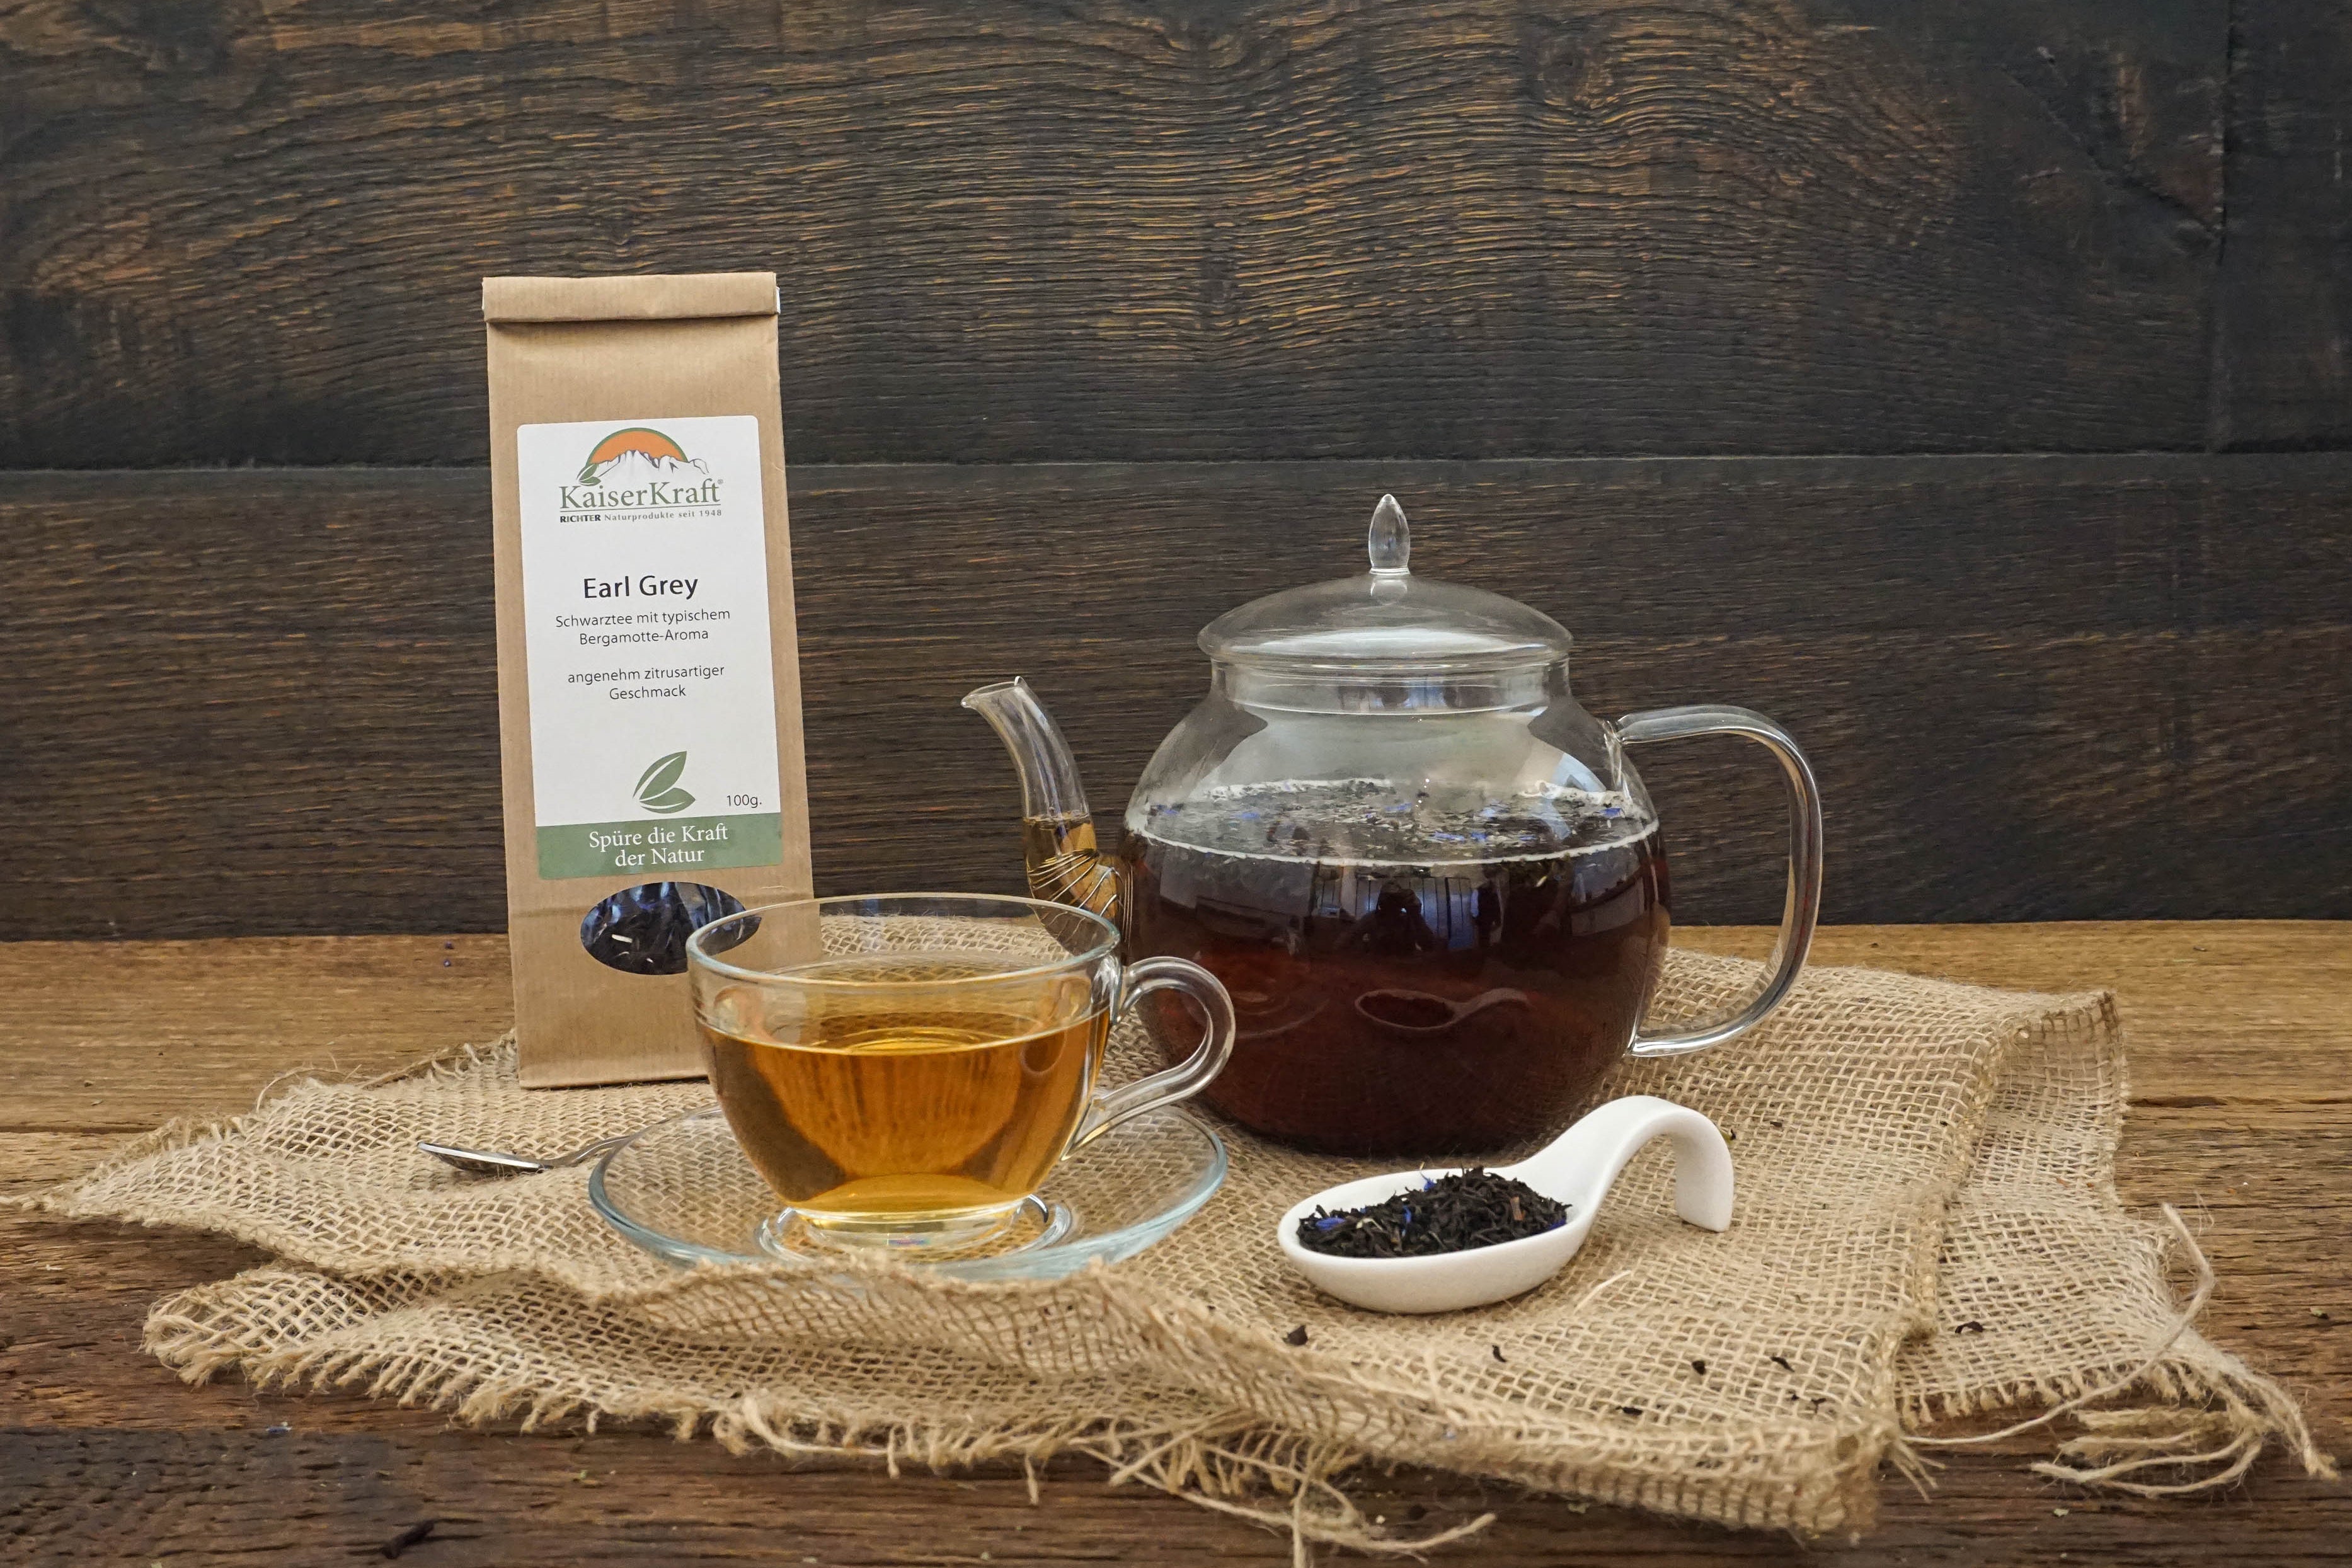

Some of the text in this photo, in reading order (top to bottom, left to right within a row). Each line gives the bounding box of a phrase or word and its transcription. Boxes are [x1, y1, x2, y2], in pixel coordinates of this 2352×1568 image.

[559, 515, 602, 524] RICHTER
[604, 512, 675, 522] Naturprodukte
[699, 509, 722, 517] 1948
[583, 575, 699, 600] Earl Grey
[556, 609, 730, 628] Schwarztee mit typischem
[580, 629, 709, 647] Bergamotte-Aroma
[568, 665, 725, 685] angenehm zitrusartiger
[609, 684, 686, 700] Geschmack
[726, 794, 762, 808] 100g.
[589, 822, 728, 853] Spüre die Kraft
[615, 847, 705, 867] der Natur
